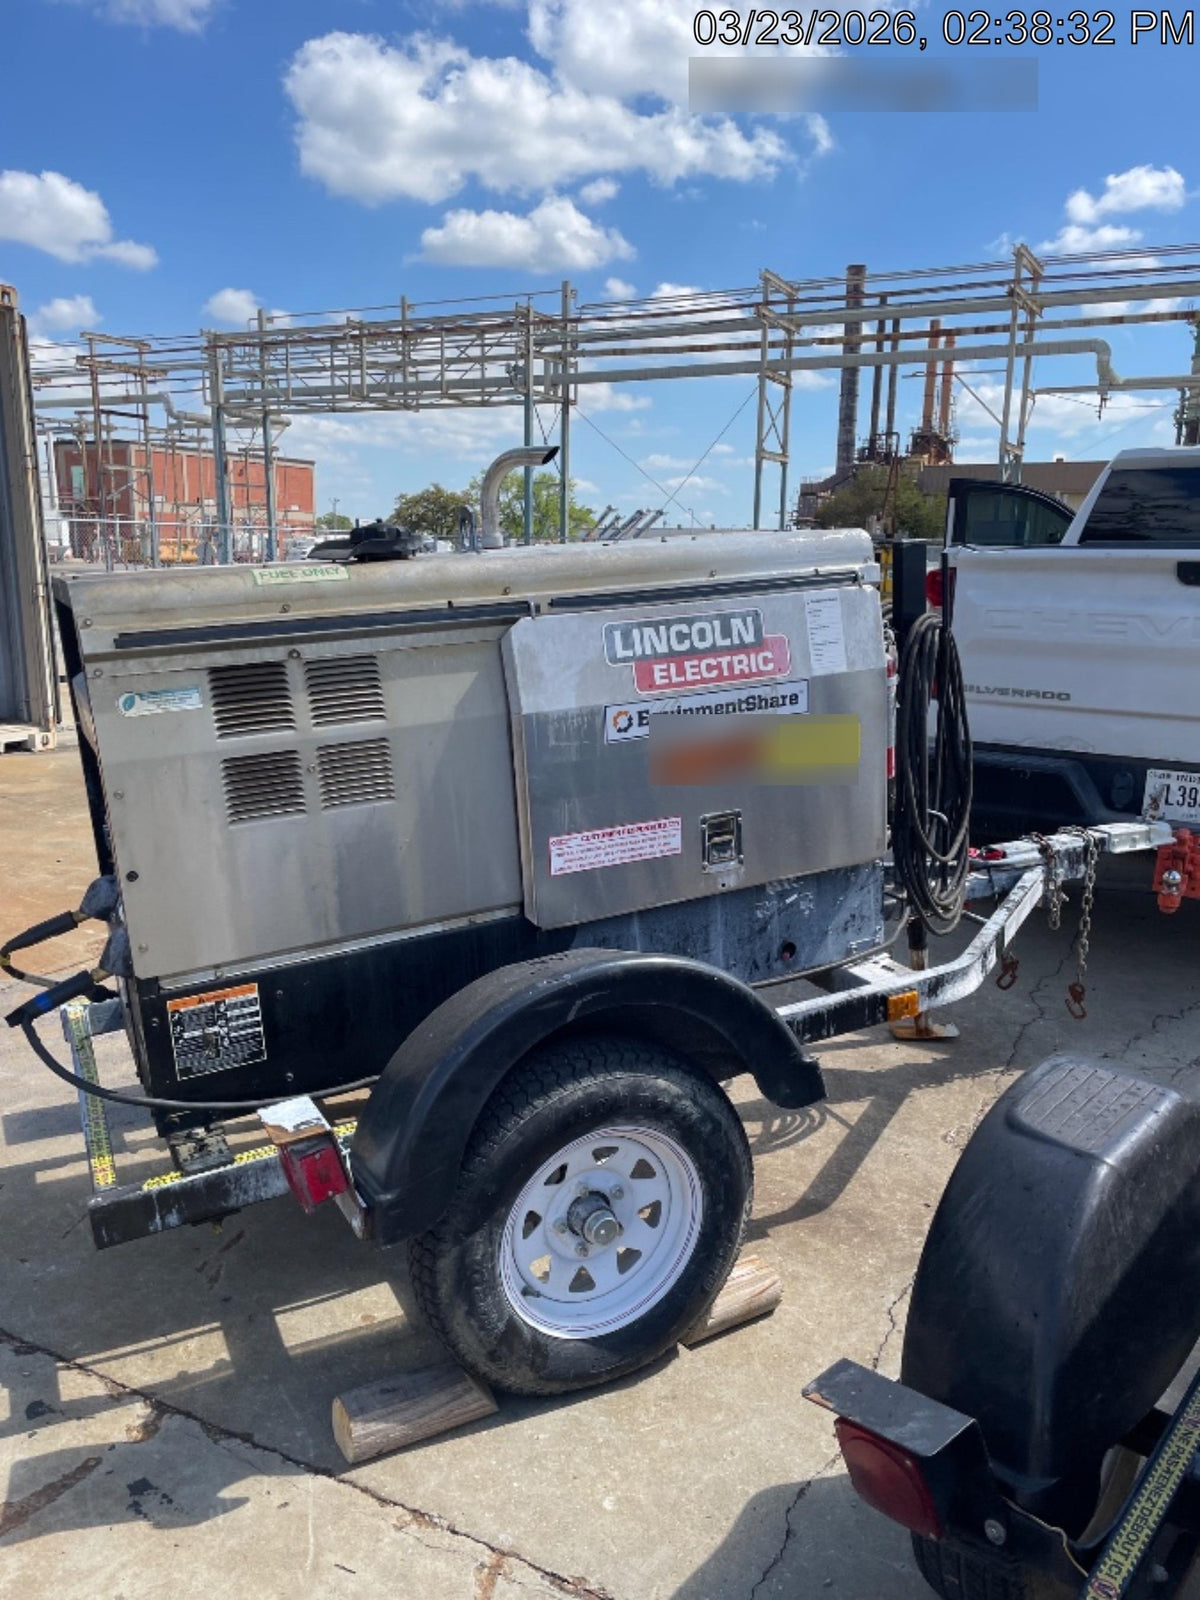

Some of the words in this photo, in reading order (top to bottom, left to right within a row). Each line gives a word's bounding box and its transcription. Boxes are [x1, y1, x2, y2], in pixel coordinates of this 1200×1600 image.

[613, 616, 756, 659] LINCOLN
[653, 651, 775, 686] ELECTRIC
[1162, 783, 1200, 808] L39
[1117, 1505, 1154, 1561] DEBOUT
[1106, 1559, 1124, 1580] ICI
